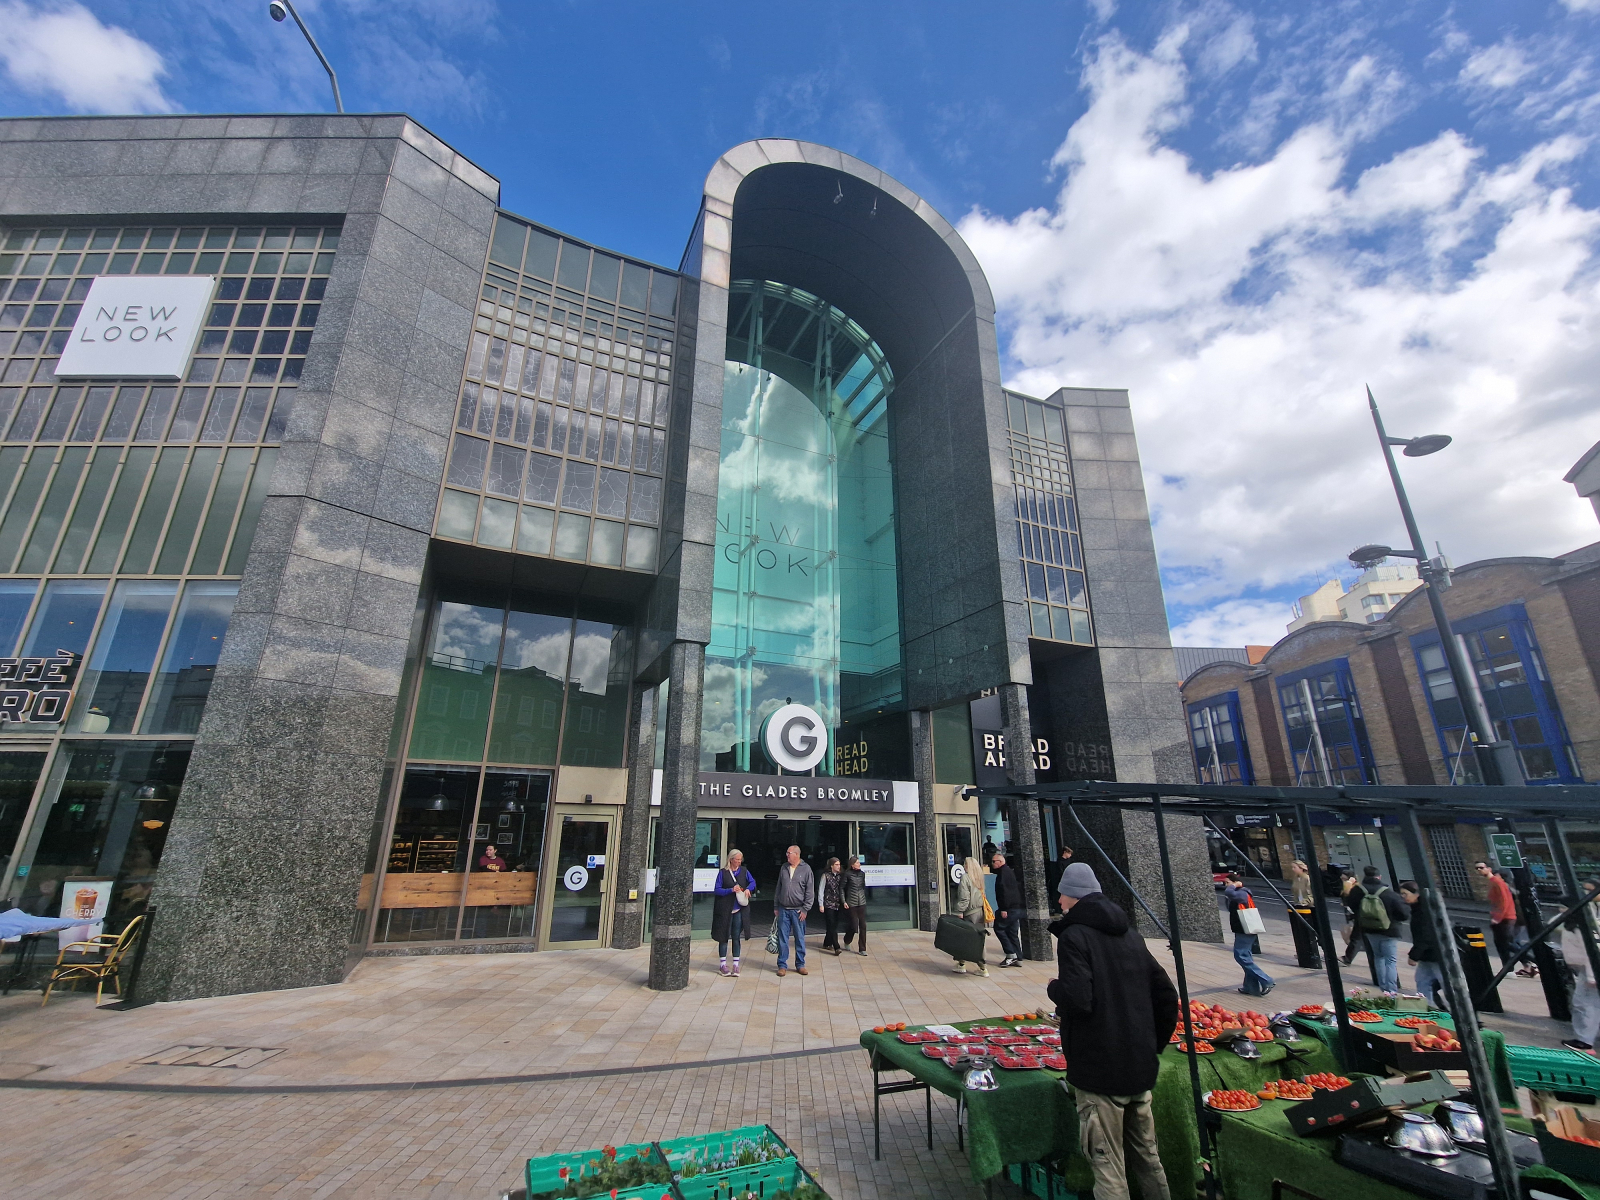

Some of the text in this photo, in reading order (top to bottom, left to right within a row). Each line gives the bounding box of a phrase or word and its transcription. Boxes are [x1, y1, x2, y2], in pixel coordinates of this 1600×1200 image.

[96, 305, 177, 321] NEW
[80, 326, 177, 342] LOOK
[724, 543, 808, 577] OOK
[781, 716, 818, 758] G
[836, 741, 868, 760] READ
[836, 757, 868, 776] HEAD
[699, 782, 889, 802] THE GLADES BROMLEY
[570, 871, 582, 885] G
[65, 908, 103, 917] CHERRY
